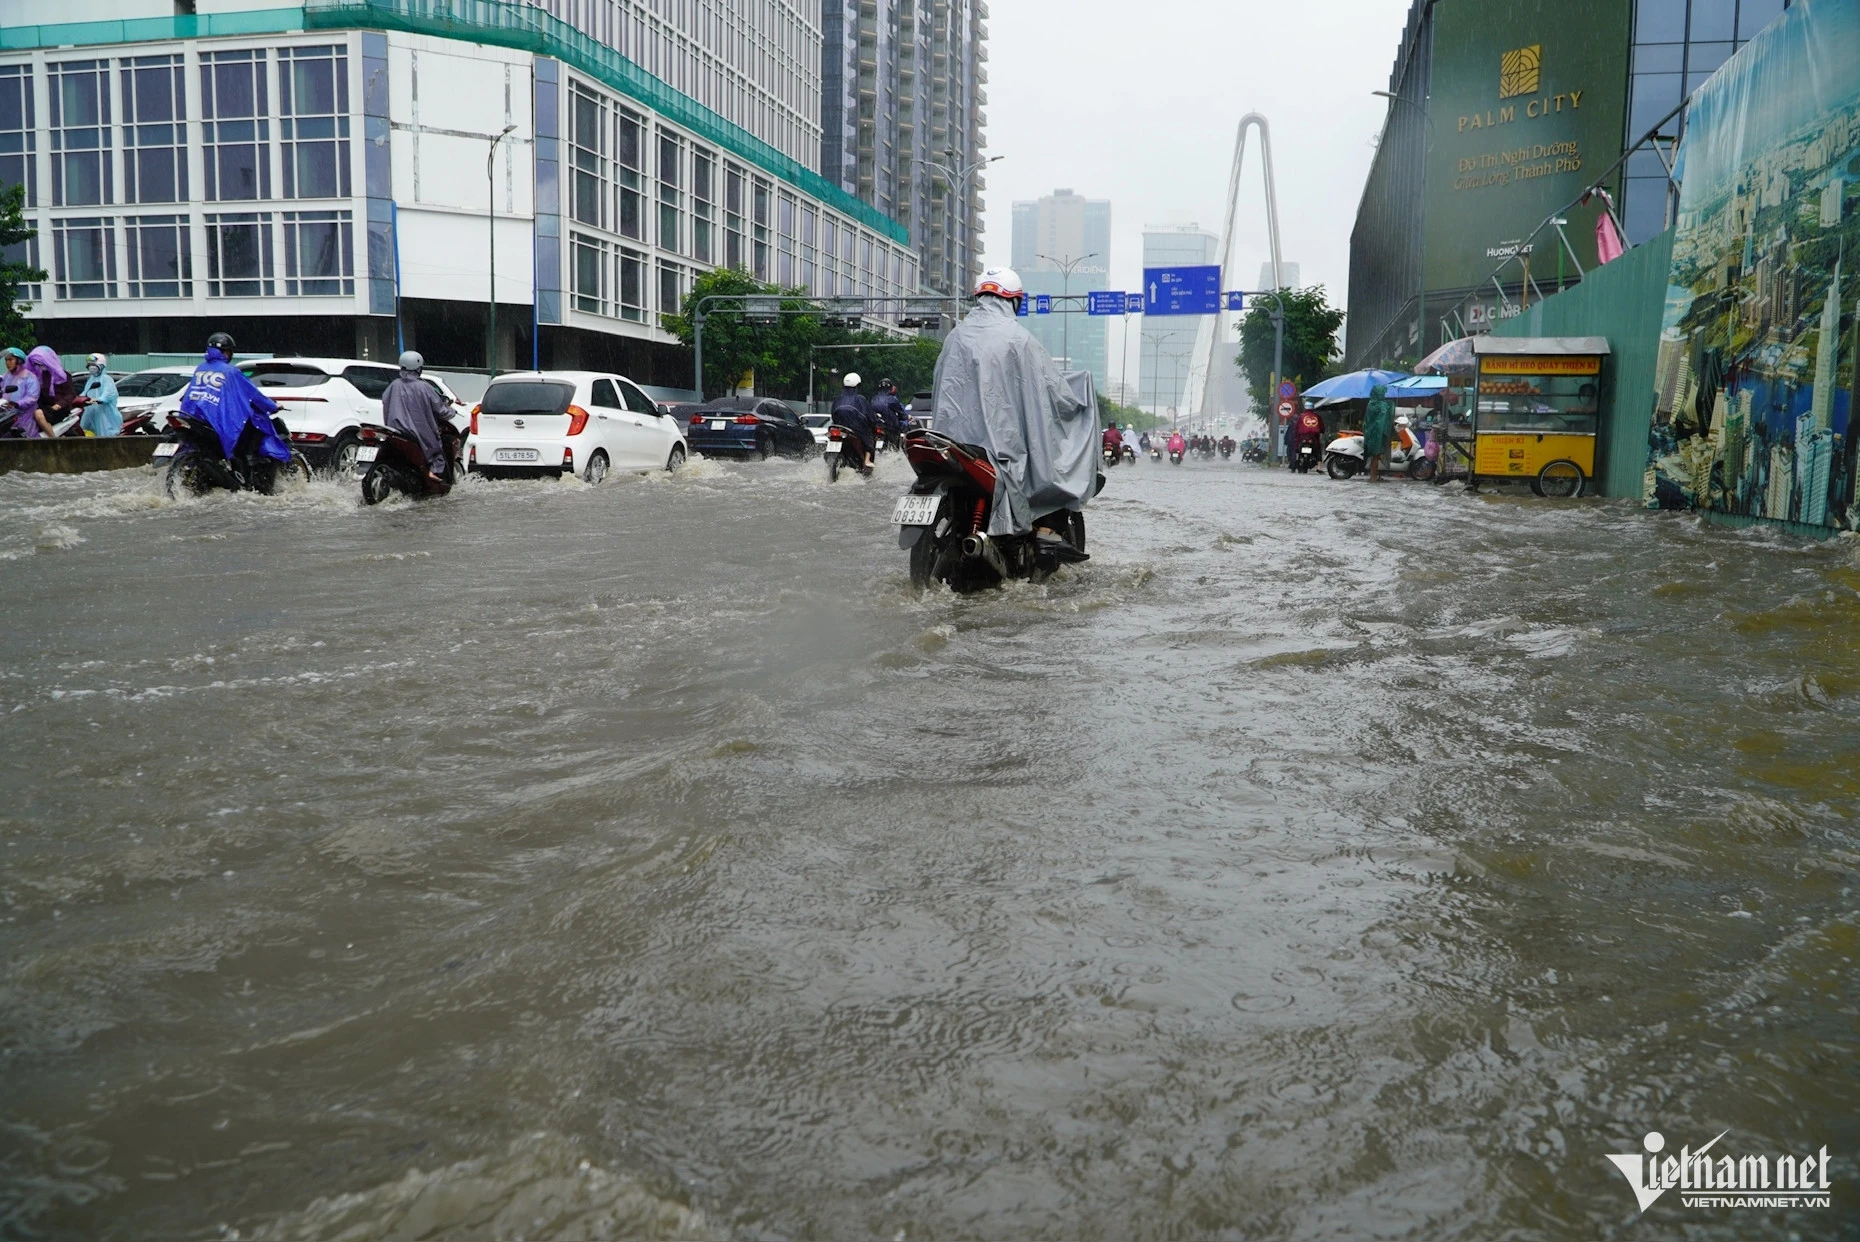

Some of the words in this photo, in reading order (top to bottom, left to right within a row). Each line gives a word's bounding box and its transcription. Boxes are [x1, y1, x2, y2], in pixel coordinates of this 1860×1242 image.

[1458, 105, 1515, 132] PALM
[1526, 90, 1583, 118] CITY
[1533, 141, 1578, 159] Dưỡng
[1513, 161, 1552, 179] Thành
[1555, 154, 1582, 173] Phố
[1520, 360, 1536, 369] HEO
[1537, 360, 1560, 370] QUAY
[195, 371, 226, 388] TCC
[903, 497, 933, 509] 76-H1
[894, 510, 933, 523] 083.91
